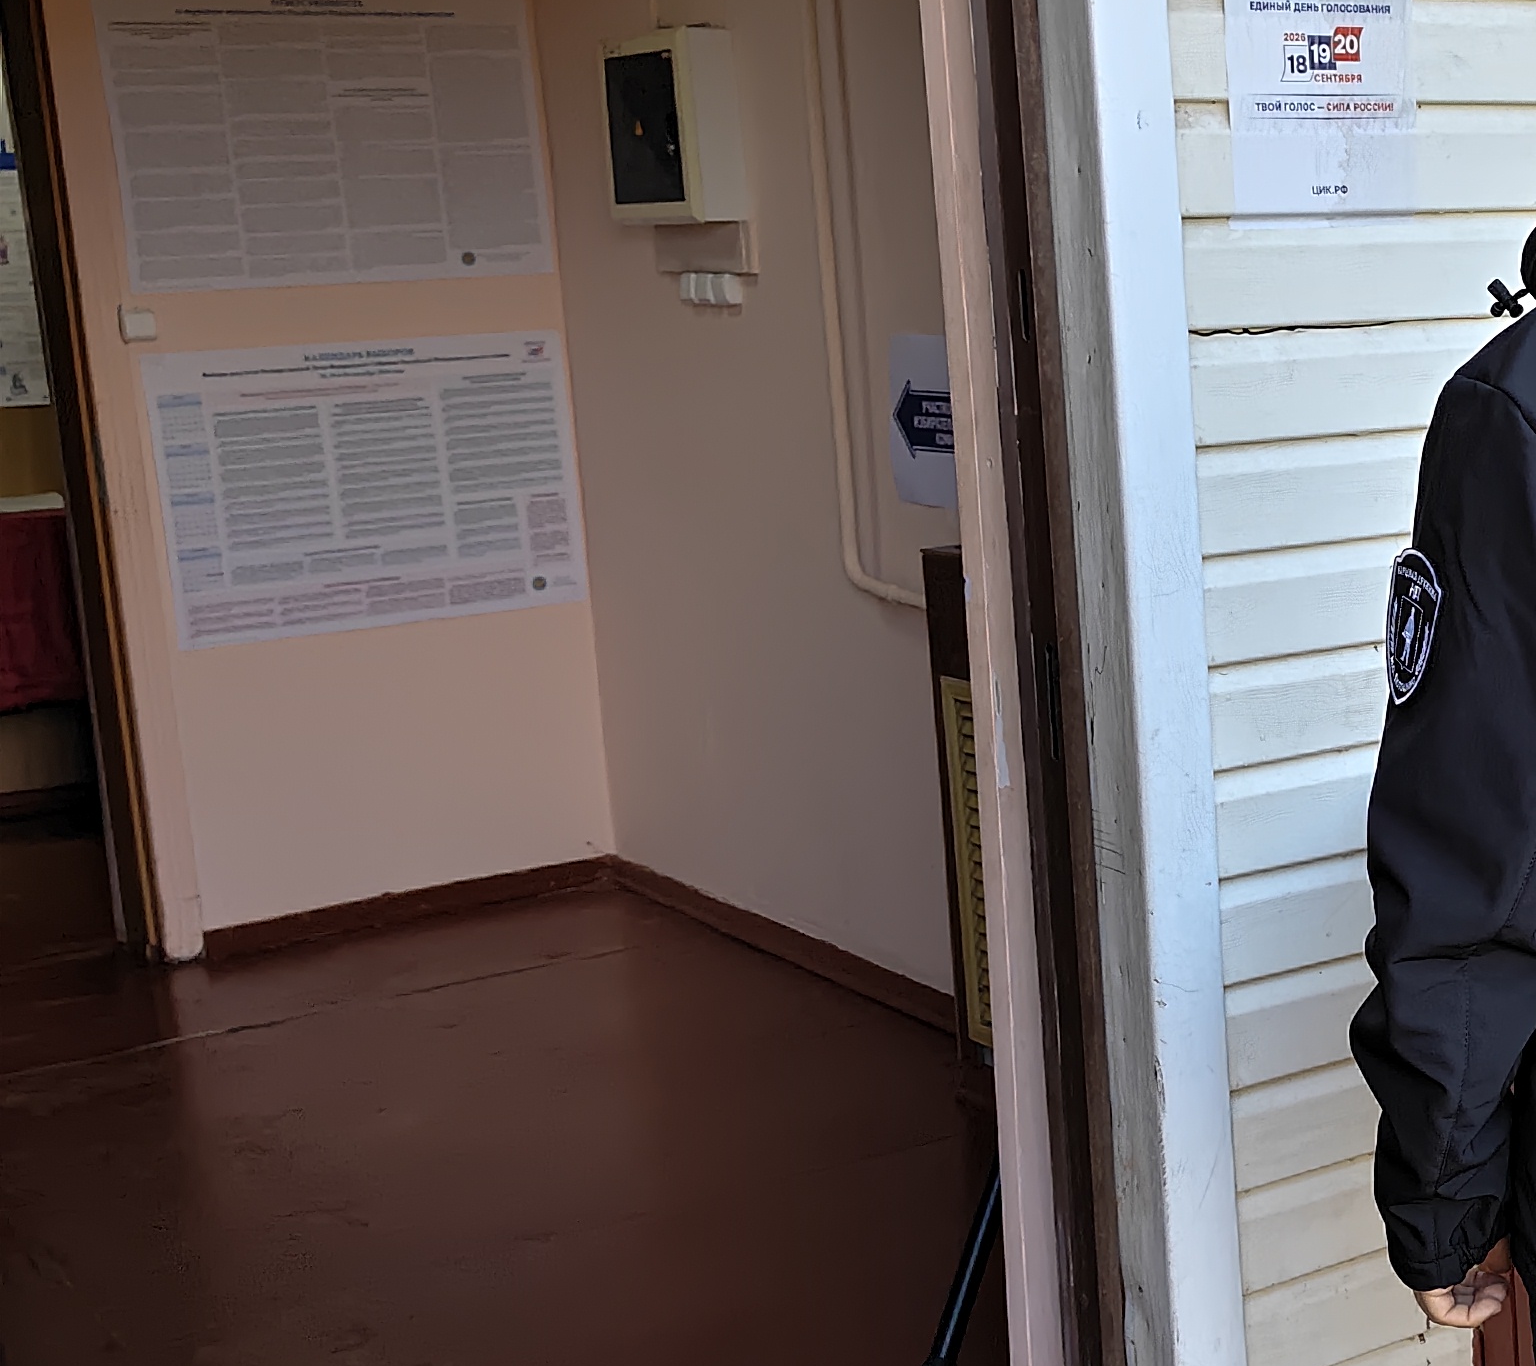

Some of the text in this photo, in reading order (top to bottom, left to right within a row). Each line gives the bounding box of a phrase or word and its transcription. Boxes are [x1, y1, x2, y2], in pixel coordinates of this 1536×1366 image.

[1249, 0, 1391, 15] ЕДИНЫЙ ДЕНЬ ГОЛОСОВАНИЯ
[1283, 33, 1306, 42] 2026
[1287, 34, 1358, 74] 18 19 20
[1314, 73, 1362, 84] СЕНТЯБРЯ
[1255, 99, 1282, 113] ТВОЙ
[1284, 101, 1316, 113] ГОЛОС
[1326, 101, 1351, 113] СИЛА
[1353, 101, 1394, 113] РОССИИ!
[1312, 184, 1348, 197] ЦИК.РФ
